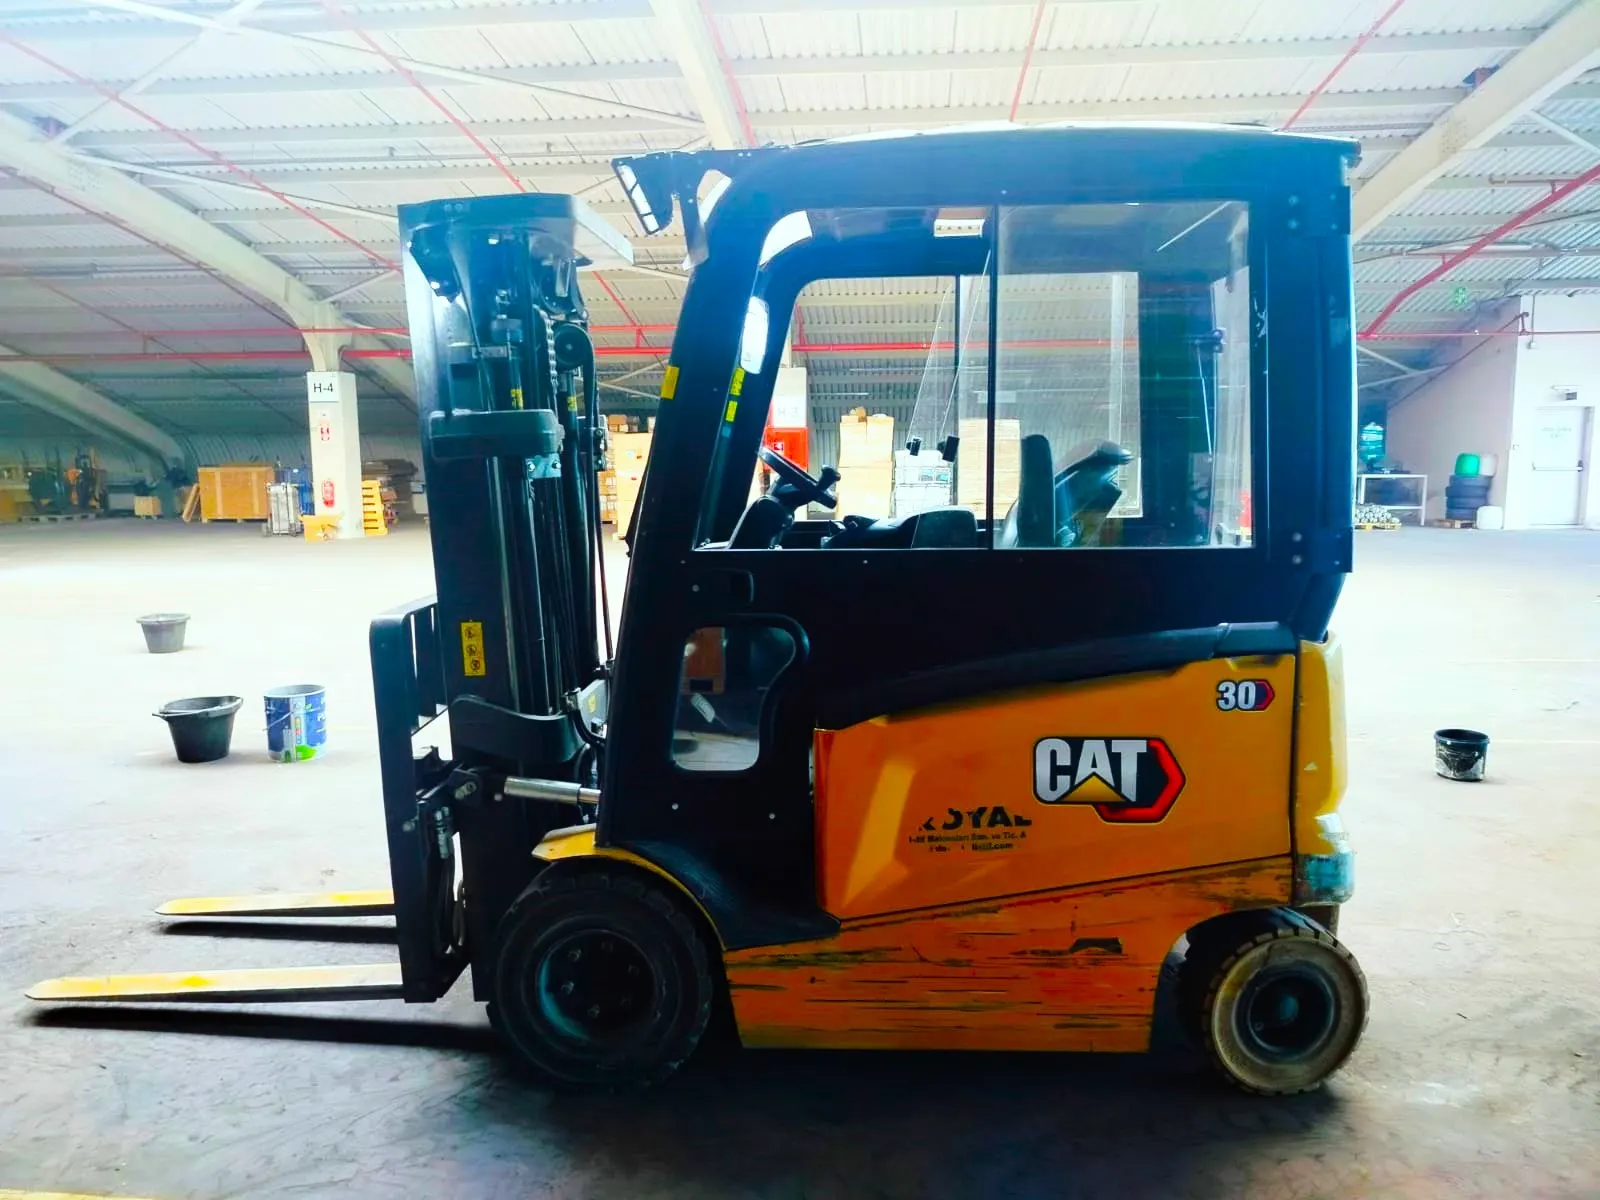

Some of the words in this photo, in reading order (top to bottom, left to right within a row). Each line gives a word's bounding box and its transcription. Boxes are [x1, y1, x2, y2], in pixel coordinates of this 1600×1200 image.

[313, 383, 333, 392] H-4
[1217, 681, 1256, 710] 30
[1035, 738, 1147, 802] CAT
